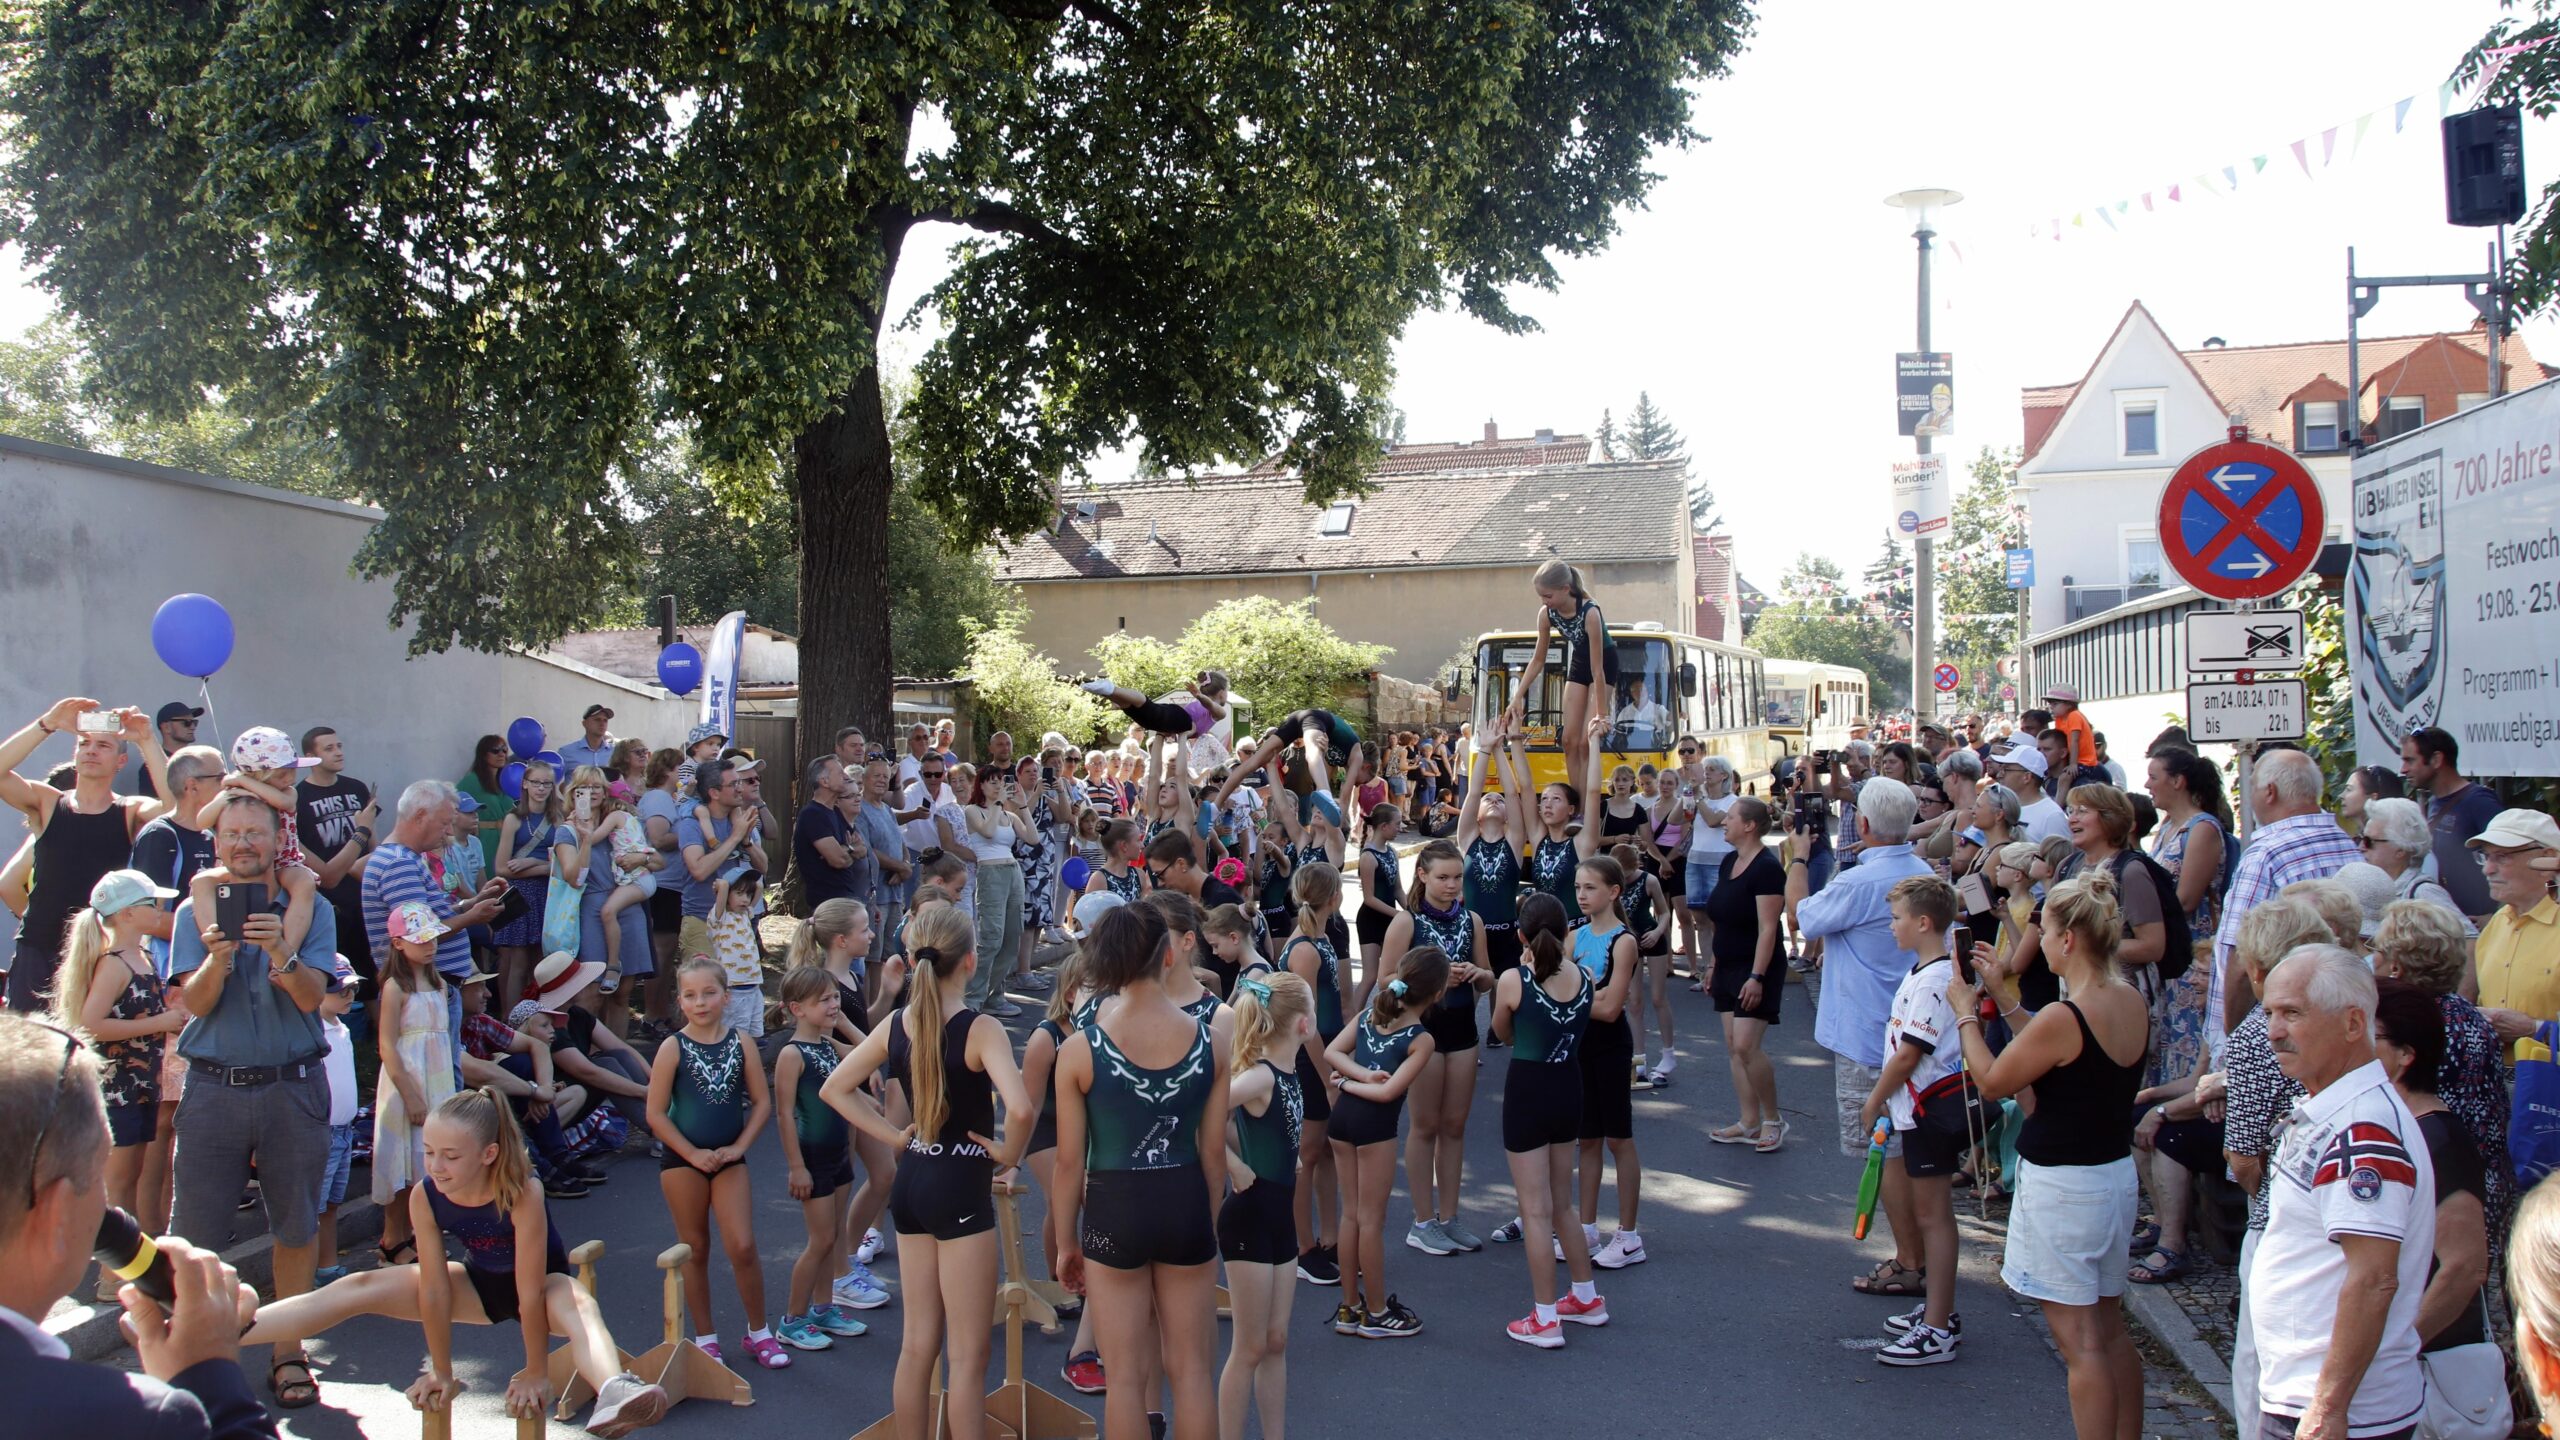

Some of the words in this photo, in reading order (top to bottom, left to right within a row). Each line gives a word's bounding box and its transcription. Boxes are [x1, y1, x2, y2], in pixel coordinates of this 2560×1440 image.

[1892, 458, 1943, 473] Mahlzeit,
[2454, 452, 2487, 500] 700
[2491, 440, 2552, 489] Jahre
[2419, 499, 2438, 529] E.V.
[2477, 588, 2518, 622] 19.08.
[2463, 667, 2537, 700] Programm
[709, 675, 723, 724] ERT
[2204, 695, 2219, 709] am
[2205, 716, 2220, 734] bis
[1792, 740, 1798, 752] 4
[309, 795, 344, 818] THIS
[345, 793, 362, 810] IS
[1484, 922, 1510, 931] PRO
[1911, 1019, 1939, 1038] NIGRIN
[1145, 1122, 1161, 1140] Dresden
[909, 1138, 944, 1156] PRO
[951, 1143, 991, 1159] NIK
